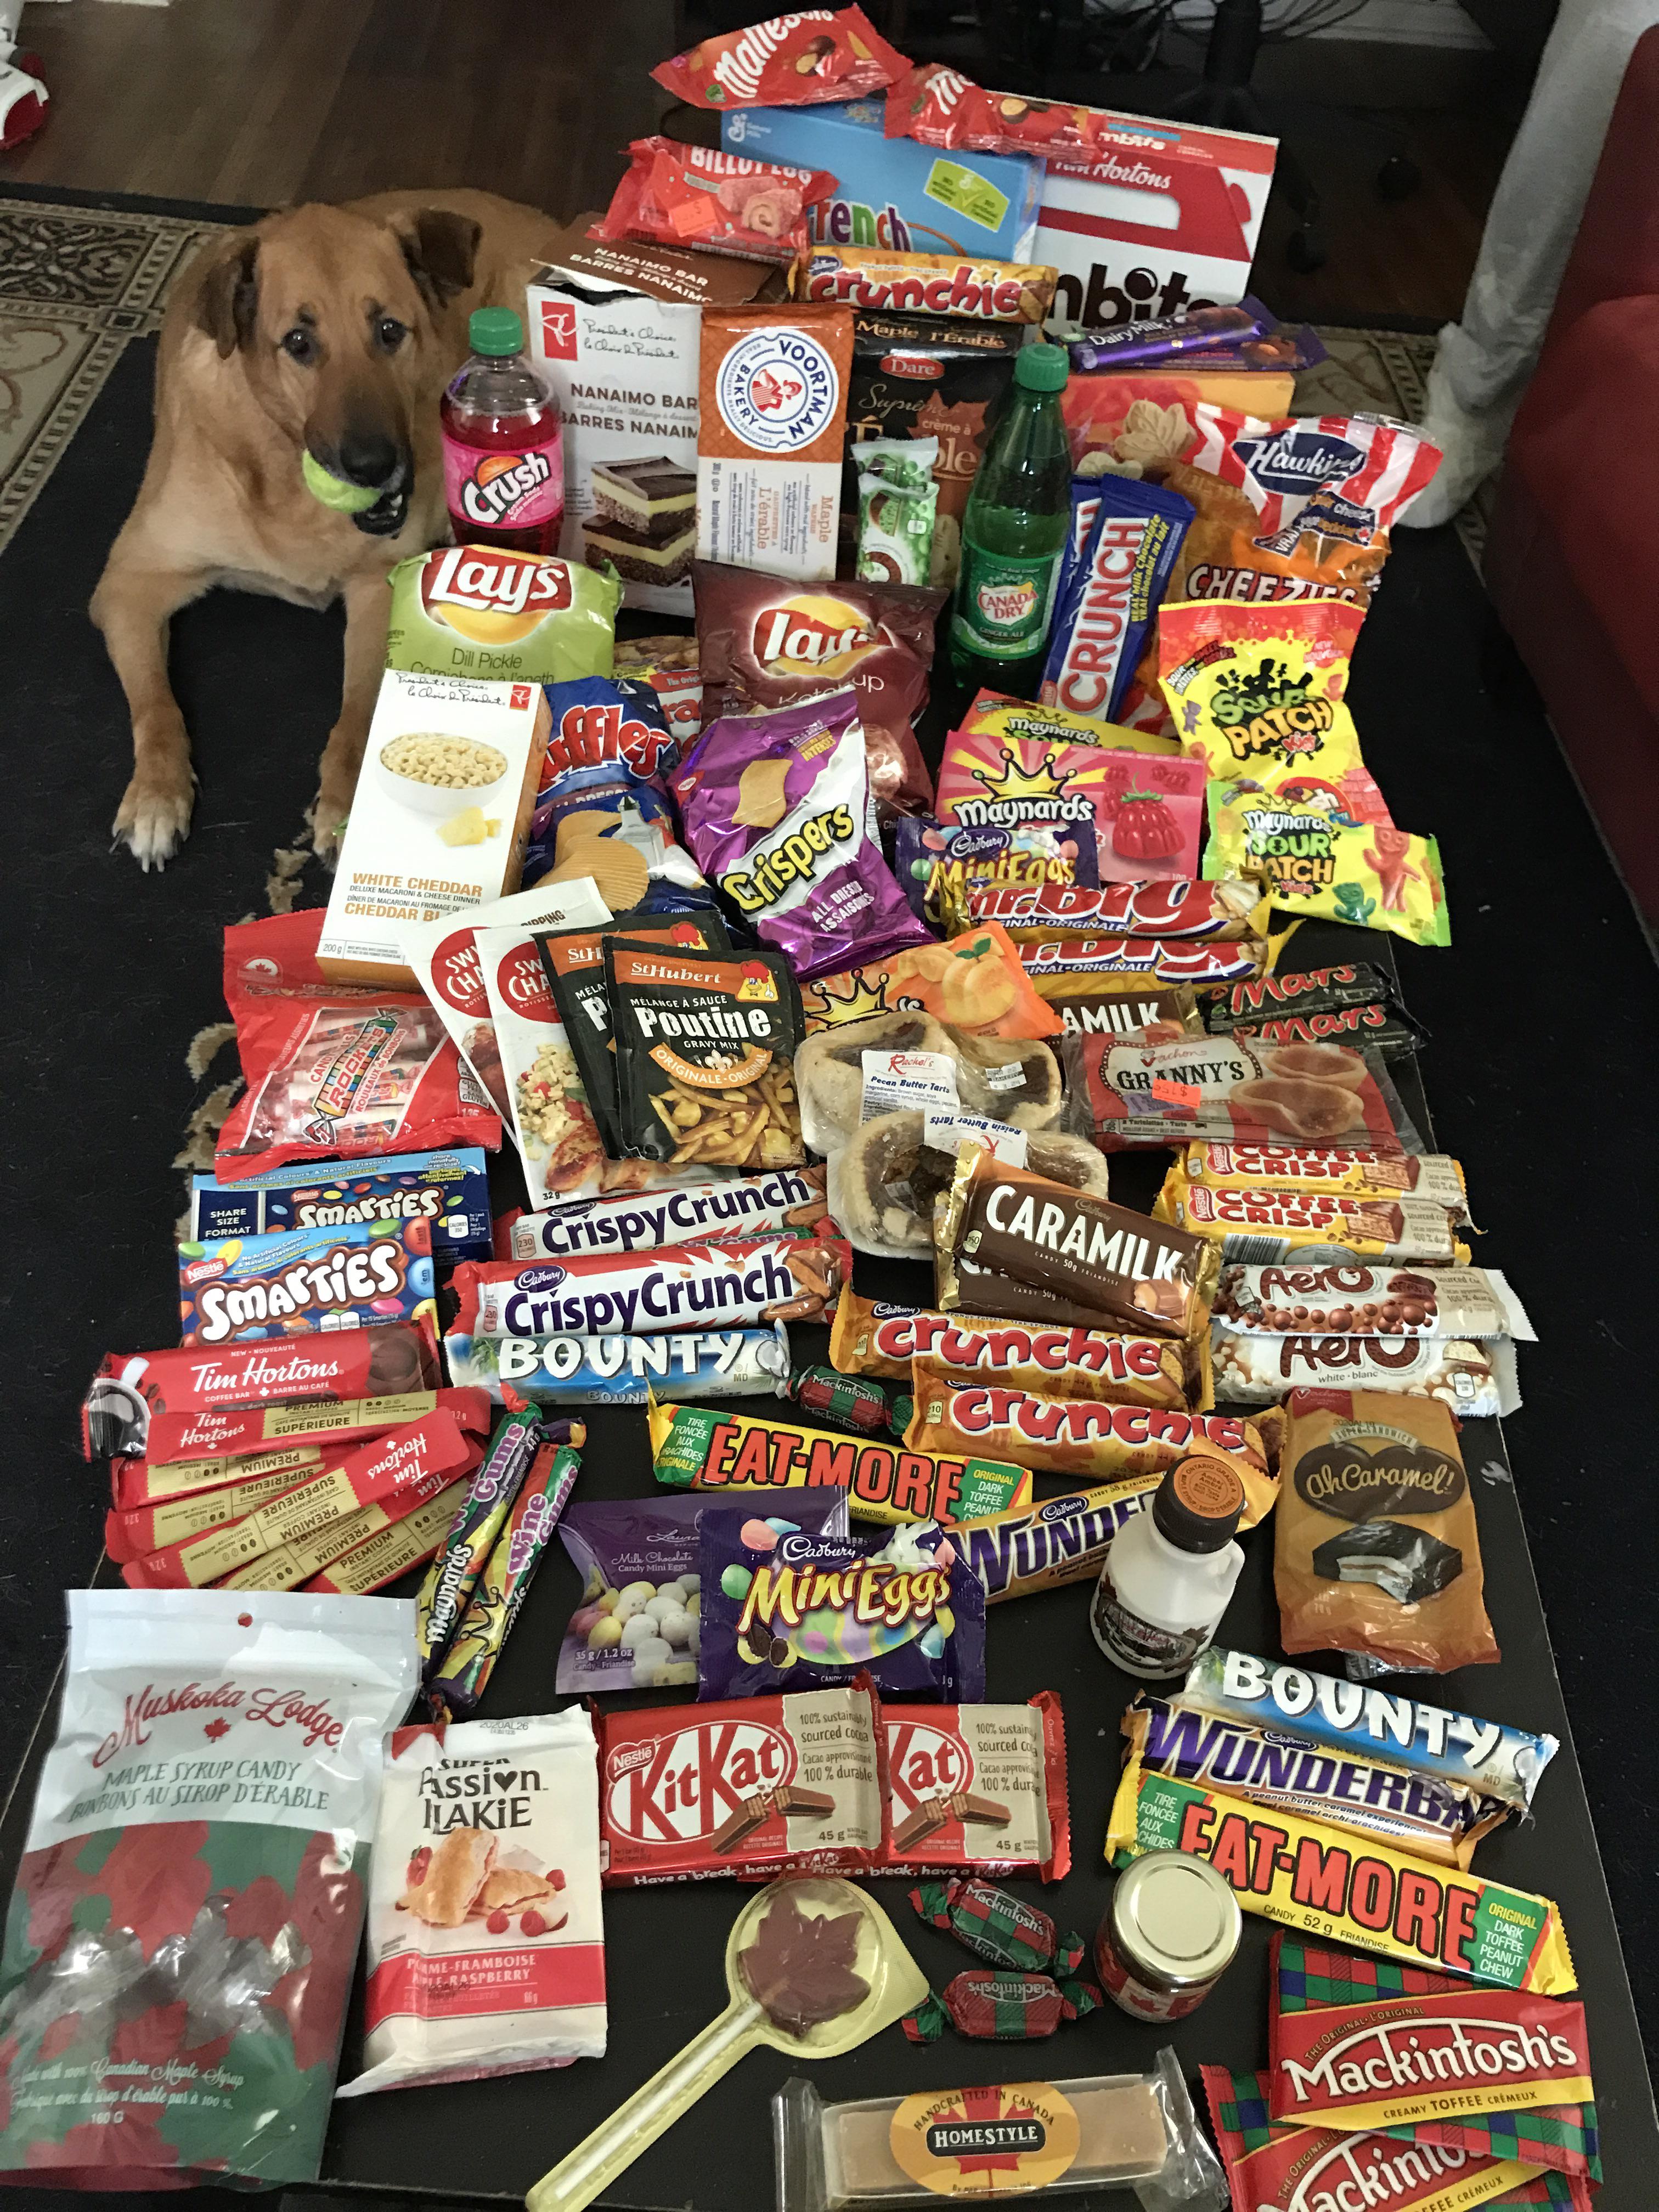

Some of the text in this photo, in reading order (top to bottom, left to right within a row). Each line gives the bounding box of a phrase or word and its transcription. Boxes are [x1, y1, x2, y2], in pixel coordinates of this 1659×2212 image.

[808, 201, 913, 252] rench
[594, 247, 672, 274] NANAIMO
[810, 266, 1024, 316] crunchie
[855, 320, 919, 340] Maple
[1088, 328, 1134, 346] Dairy
[890, 359, 936, 376] Dare
[571, 383, 698, 410] NANAIMO BAR
[733, 363, 759, 426] BAKERY
[779, 339, 827, 439] VOORTMAN
[561, 411, 624, 431] BARRES
[922, 418, 961, 434] crème
[464, 452, 550, 523] Crush
[818, 495, 834, 543] Maple
[1135, 514, 1161, 569] Chocolate
[428, 548, 566, 613] Lay's
[978, 590, 1039, 610] CANADA
[994, 606, 1024, 619] DRY
[1059, 521, 1144, 713] CRUNCH
[452, 647, 522, 669] Dill Pickle
[1008, 717, 1099, 745] Maynards
[1224, 697, 1333, 757] PATCH
[538, 706, 674, 778] uffles
[953, 795, 1095, 827] Maynards
[951, 830, 1010, 857] Cadbury
[722, 803, 854, 912] Crispers
[349, 885, 481, 905] DELUXE MACARONI CHEESE DINNER
[353, 872, 483, 898] WHITE CHEDDAR
[344, 902, 419, 921] CHEDDAR
[376, 898, 410, 907] MACARONI
[420, 902, 452, 912] FROMAGE
[323, 943, 336, 952] 200
[630, 997, 680, 1008] MÉLANGE
[692, 995, 728, 1007] SAUCE
[1231, 963, 1358, 1015] Mars
[634, 1006, 772, 1039] Poutine
[1063, 1003, 1161, 1035] AMILK
[1262, 1004, 1387, 1043] Mars
[381, 1028, 408, 1061] BONBONS
[684, 1040, 740, 1050] GRAVY MIX
[327, 1026, 387, 1110] ROCKETS
[655, 1048, 723, 1085] ORIGINALE
[888, 1053, 934, 1075] Rachel's
[871, 1075, 950, 1094] Pecan Butter Tarts
[929, 1115, 1022, 1135] Raisin Butter Tarts
[1235, 1159, 1351, 1178] CRISP
[210, 1208, 247, 1218] SHARE
[296, 1189, 441, 1229] SMARTIES
[1215, 1188, 1361, 1215] COFFEE
[216, 1216, 240, 1226] SIZE
[1217, 1206, 1335, 1229] CRISP
[205, 1226, 252, 1237] FORMAT
[986, 1184, 1184, 1285] CARAMILK
[188, 1261, 225, 1282] Nestlé
[517, 1266, 563, 1290] Cadbury
[202, 1244, 399, 1341] SMARTIES
[230, 1343, 296, 1357] NEW NOUVEAUTÉ
[499, 1331, 744, 1380] BOUNTY
[878, 1314, 1161, 1380] crunchie
[190, 1357, 340, 1392] Tim Hortons
[273, 1380, 330, 1395] BARRE CAFÉ
[1318, 1370, 1379, 1383] white blanc
[205, 1391, 251, 1402] COFFEE BAR
[812, 1374, 881, 1404] Mackintosh's
[193, 1411, 227, 1428] Tim
[687, 1415, 707, 1429] TIRE
[952, 1387, 1245, 1451] crunchie
[180, 1422, 246, 1447] Hortons
[674, 1424, 708, 1441] FONCÉE
[676, 1436, 694, 1448] AUX
[474, 1423, 527, 1503] Gums
[703, 1423, 967, 1525] EAT-MORE
[973, 1468, 1015, 1486] ORIGINAL
[978, 1480, 1004, 1493] DARK
[970, 1489, 1004, 1506] TOFFEE
[506, 1492, 549, 1575] Wine
[611, 1550, 694, 1566] Milk Chocolate
[782, 1536, 856, 1561] Cadbury
[618, 1562, 689, 1575] Candy Mini Eggs
[425, 1543, 474, 1643] Maynards
[799, 1713, 821, 1725] 100%
[1222, 1650, 1503, 1769] BOUNTY
[92, 1680, 345, 1769] Muskoka Lodge
[800, 1727, 870, 1744] sourced cocoa
[104, 1759, 303, 1786] MAPLE SYRUP CANDY
[612, 1746, 654, 1773] Nestlé
[629, 1723, 781, 1840] KitKat
[836, 1765, 873, 1782] durable
[68, 1780, 330, 1824] BONBONS AU SIROP D'ÉRABLE
[1138, 1800, 1178, 1822] FONCÉE
[1154, 1791, 1178, 1809] TIRE
[1178, 1799, 1482, 1973] EAT-MORE
[966, 1884, 1046, 1936] Mackintosh's
[1487, 1901, 1538, 1931] ORIGINAL
[1263, 1904, 1391, 1954] CANDY 52 FRIANDISE
[1485, 1930, 1525, 1954] TOFFEE
[1494, 1920, 1525, 1939] DARK
[1479, 1942, 1522, 1968] PEANUT
[1479, 1957, 1515, 1979] CHEW
[968, 1981, 1058, 2004] Mackintosh's
[1282, 2017, 1578, 2103] Mackintosh's
[913, 2089, 1056, 2132] HANDCRAFTED IN CANADA
[1383, 2089, 1538, 2119] CREAMY TOFFEE CRÉMEUX
